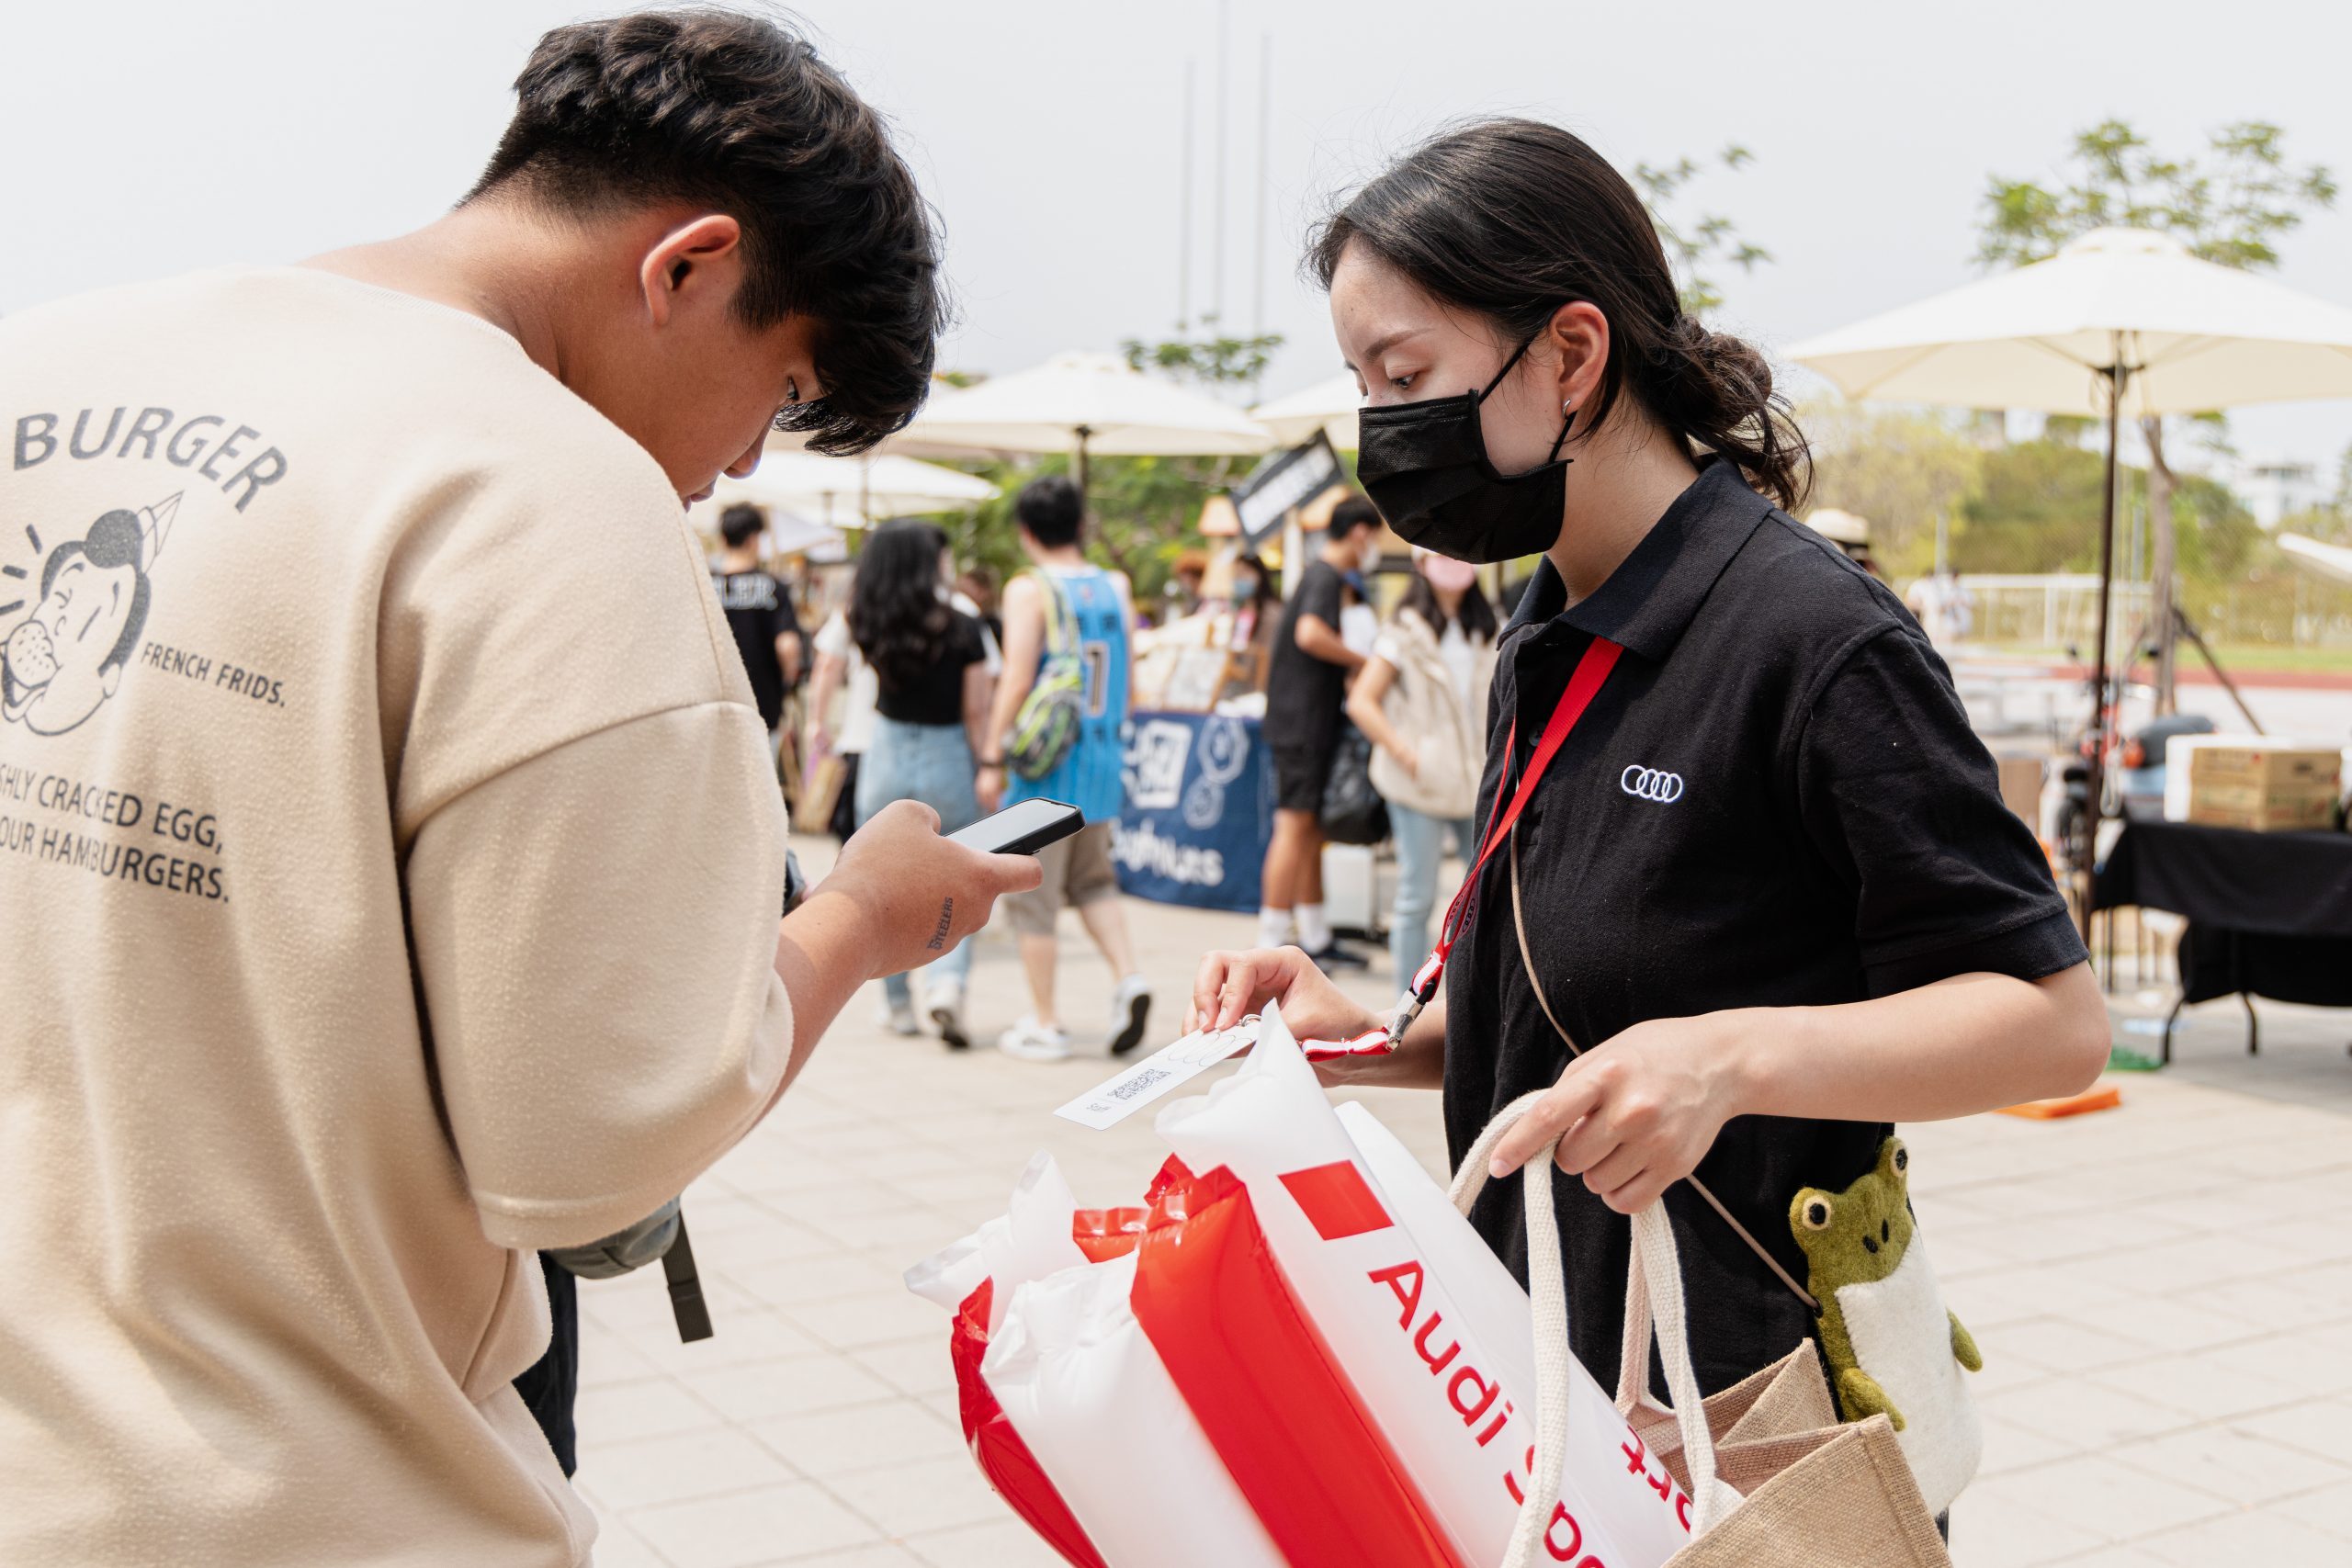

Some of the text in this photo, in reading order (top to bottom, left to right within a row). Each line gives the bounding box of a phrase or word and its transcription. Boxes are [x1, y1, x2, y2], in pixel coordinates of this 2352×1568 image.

[14, 407, 288, 513] BURGER
[141, 642, 286, 707] FRENCH FRIDS.
[39, 774, 143, 827] CRACKED
[153, 801, 222, 854] EGG,
[40, 827, 229, 902] HAMBURGERS.
[1367, 1259, 1514, 1449] Audi
